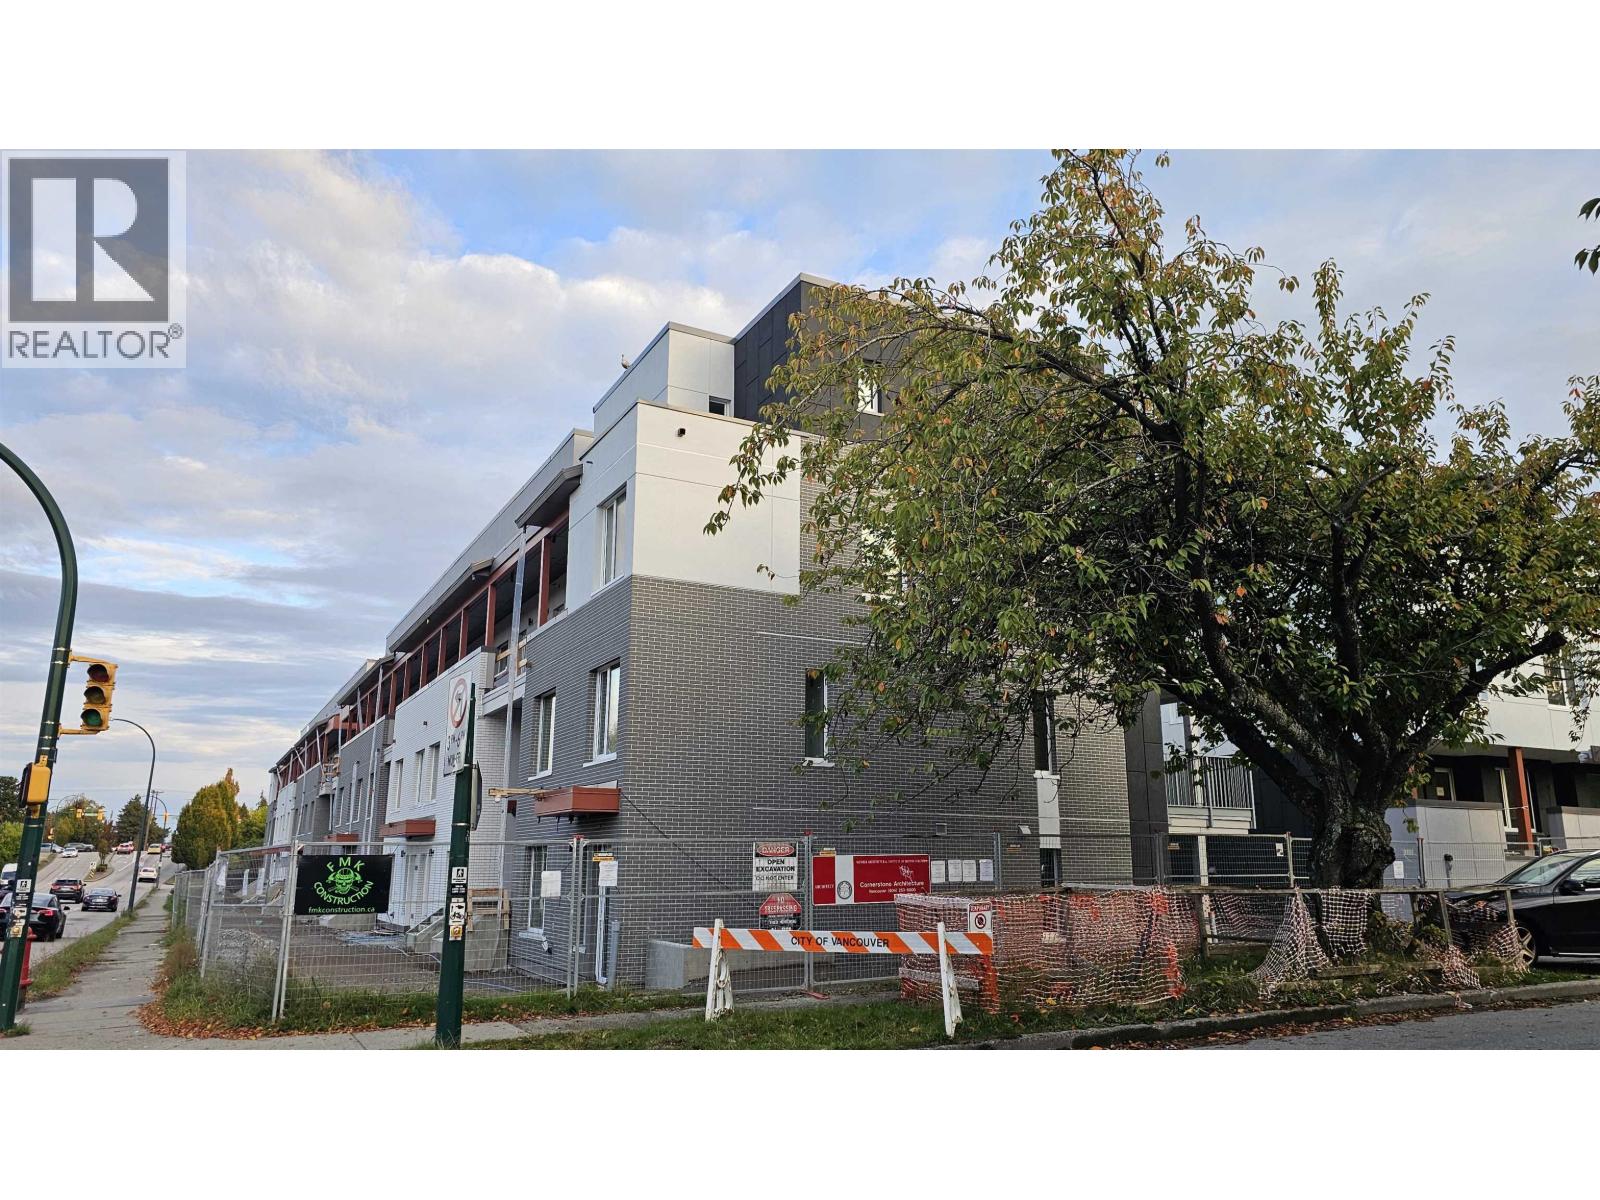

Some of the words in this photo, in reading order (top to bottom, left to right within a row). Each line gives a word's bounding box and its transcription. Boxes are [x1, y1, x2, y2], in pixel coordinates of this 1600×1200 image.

[326, 856, 366, 872] FMK
[313, 880, 374, 905] CONSTRUCTION
[308, 906, 375, 914] fmkconstruction.ca
[790, 936, 812, 946] CITY
[815, 936, 829, 946] OF
[831, 937, 890, 948] VANCOUVER
